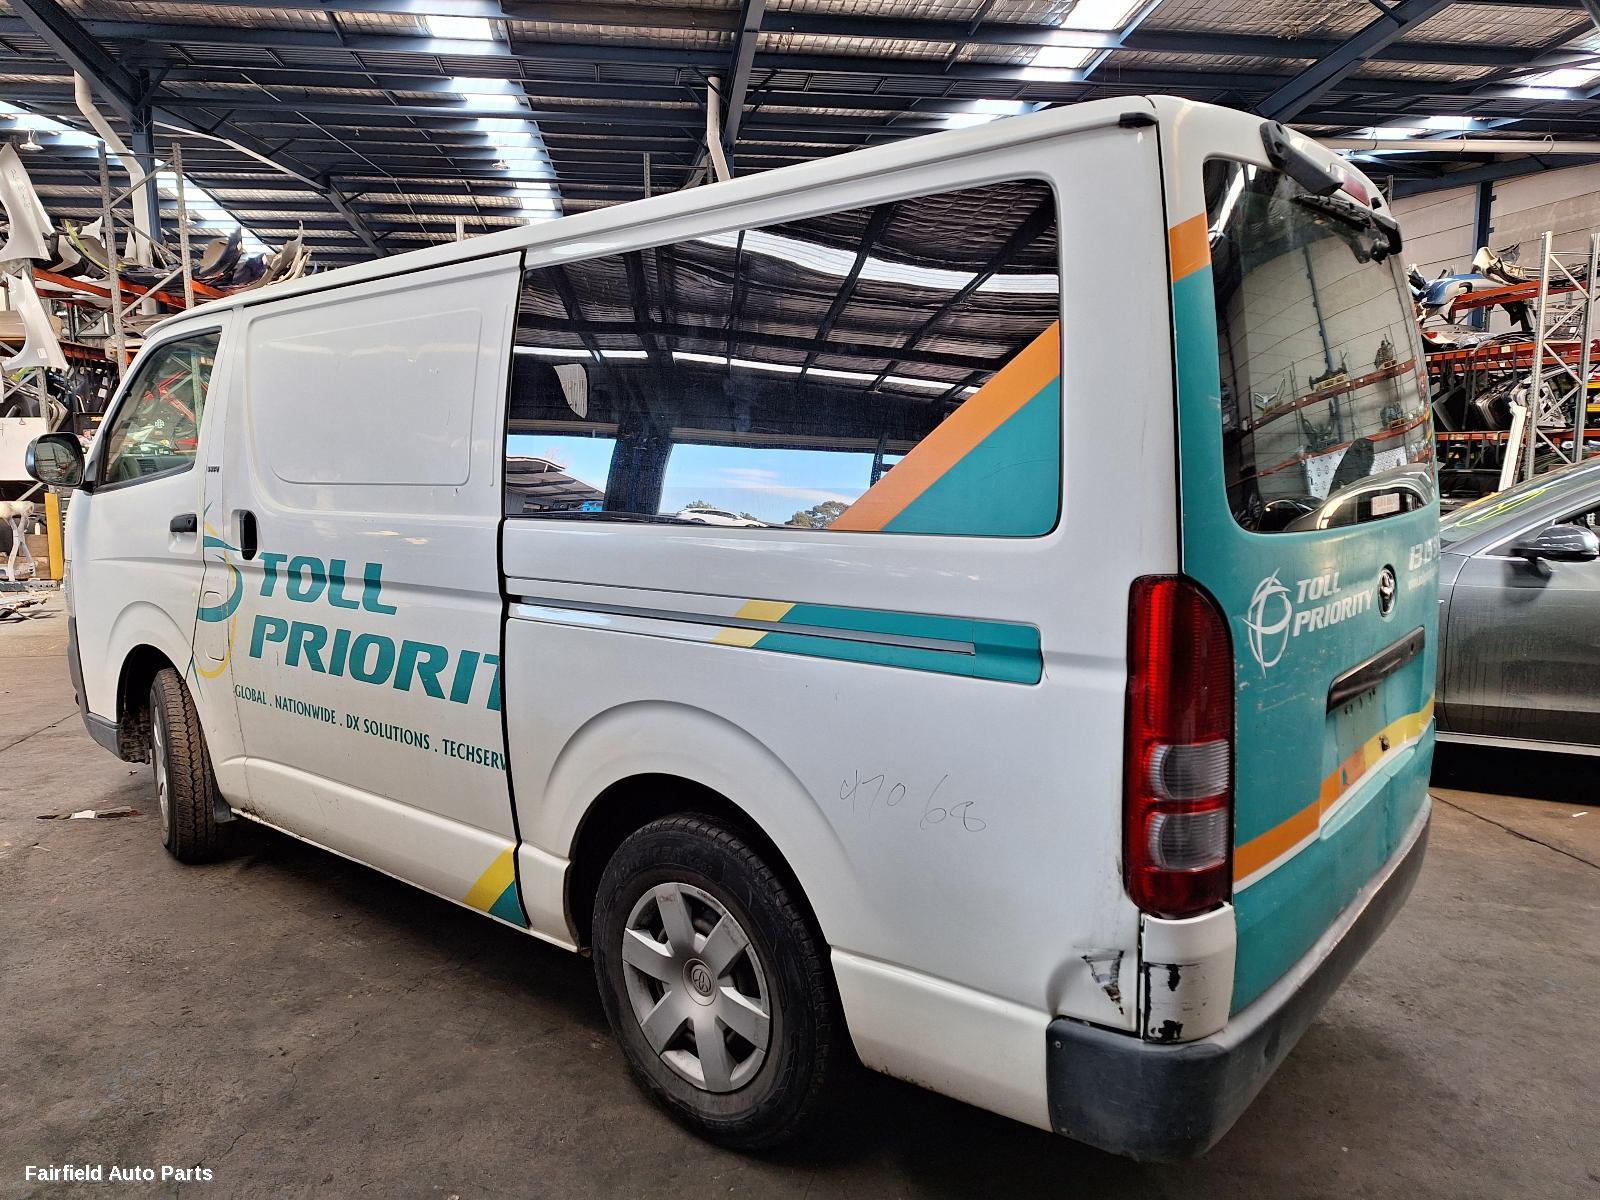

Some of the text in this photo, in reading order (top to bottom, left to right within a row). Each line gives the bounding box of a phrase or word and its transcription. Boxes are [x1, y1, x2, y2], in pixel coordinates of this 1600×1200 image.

[258, 552, 398, 616] TOLL
[1292, 587, 1375, 637] PRIORITY
[1296, 571, 1342, 604] TOLL
[234, 684, 267, 705] GLOBAL
[274, 694, 337, 725] NATIONWIDE
[346, 713, 360, 732] DX
[363, 718, 431, 750] SOLUTIONS
